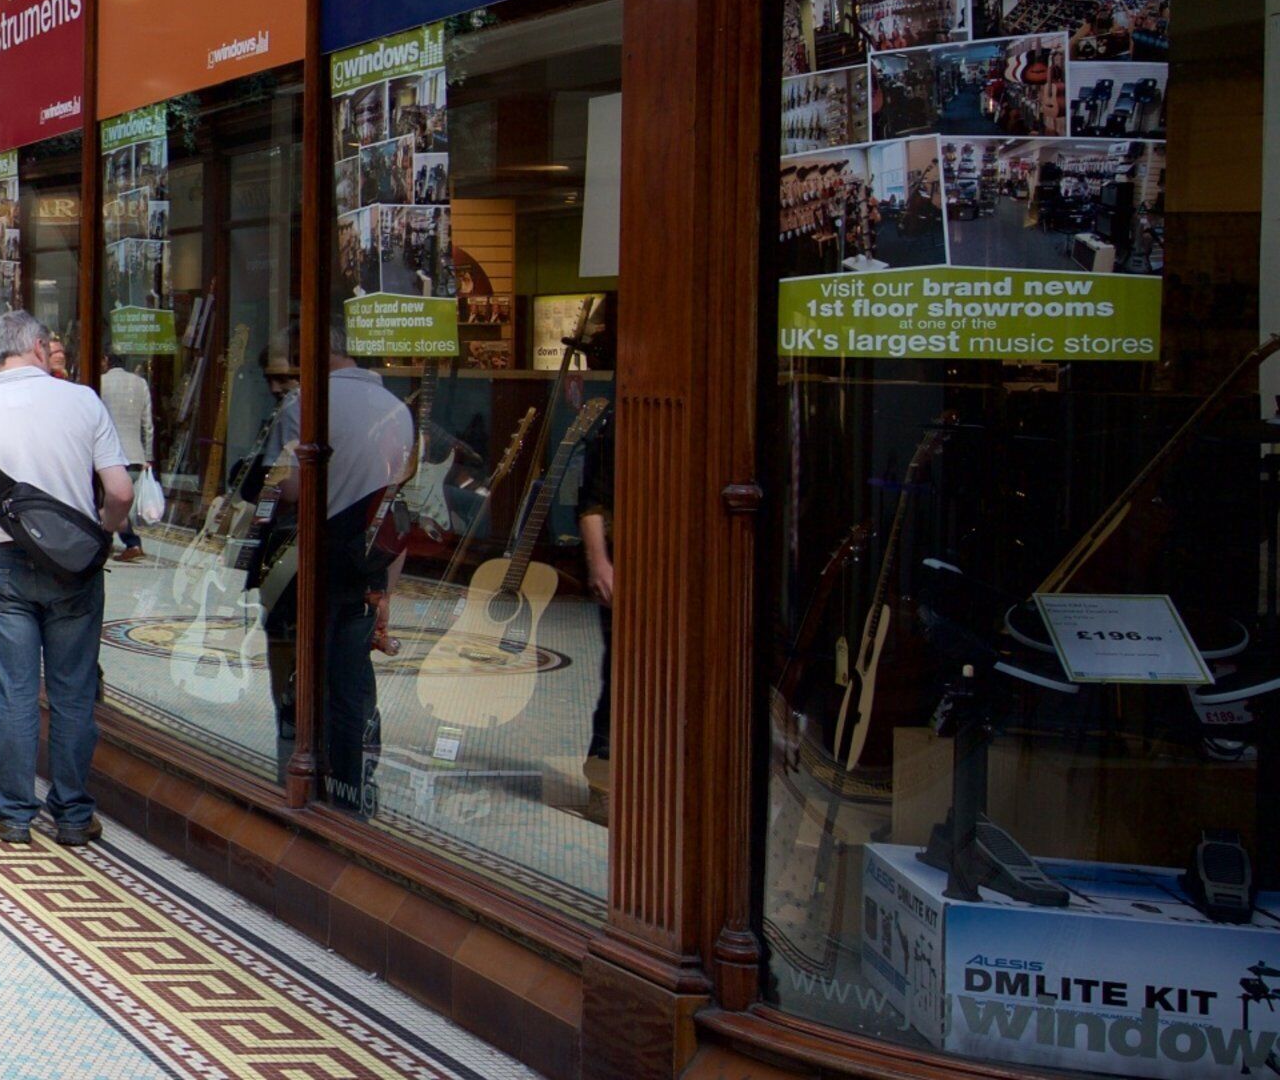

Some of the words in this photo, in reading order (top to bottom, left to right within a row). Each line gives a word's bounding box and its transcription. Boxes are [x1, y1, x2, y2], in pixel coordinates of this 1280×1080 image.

[333, 40, 419, 89] jgwindows
[820, 279, 864, 298] visit
[872, 282, 913, 296] our
[922, 277, 1011, 296] brand
[1024, 280, 1093, 295] new
[374, 300, 398, 314] brand
[401, 302, 424, 313] new
[807, 299, 844, 318] 1st
[852, 299, 918, 318] floor
[927, 299, 1114, 318] showrooms
[376, 315, 433, 328] showrooms
[899, 319, 914, 330] at
[917, 320, 946, 330] one
[950, 318, 968, 330] of
[971, 318, 997, 330] the
[414, 339, 456, 352] stores
[781, 329, 839, 351] UK's
[848, 329, 960, 357] largest
[969, 334, 1055, 354] music
[1063, 336, 1154, 354] stores
[925, 904, 938, 929] KIT
[965, 954, 1044, 972] ALESIS
[964, 967, 1129, 1007] DMLITE
[1144, 985, 1218, 1016] KIT
